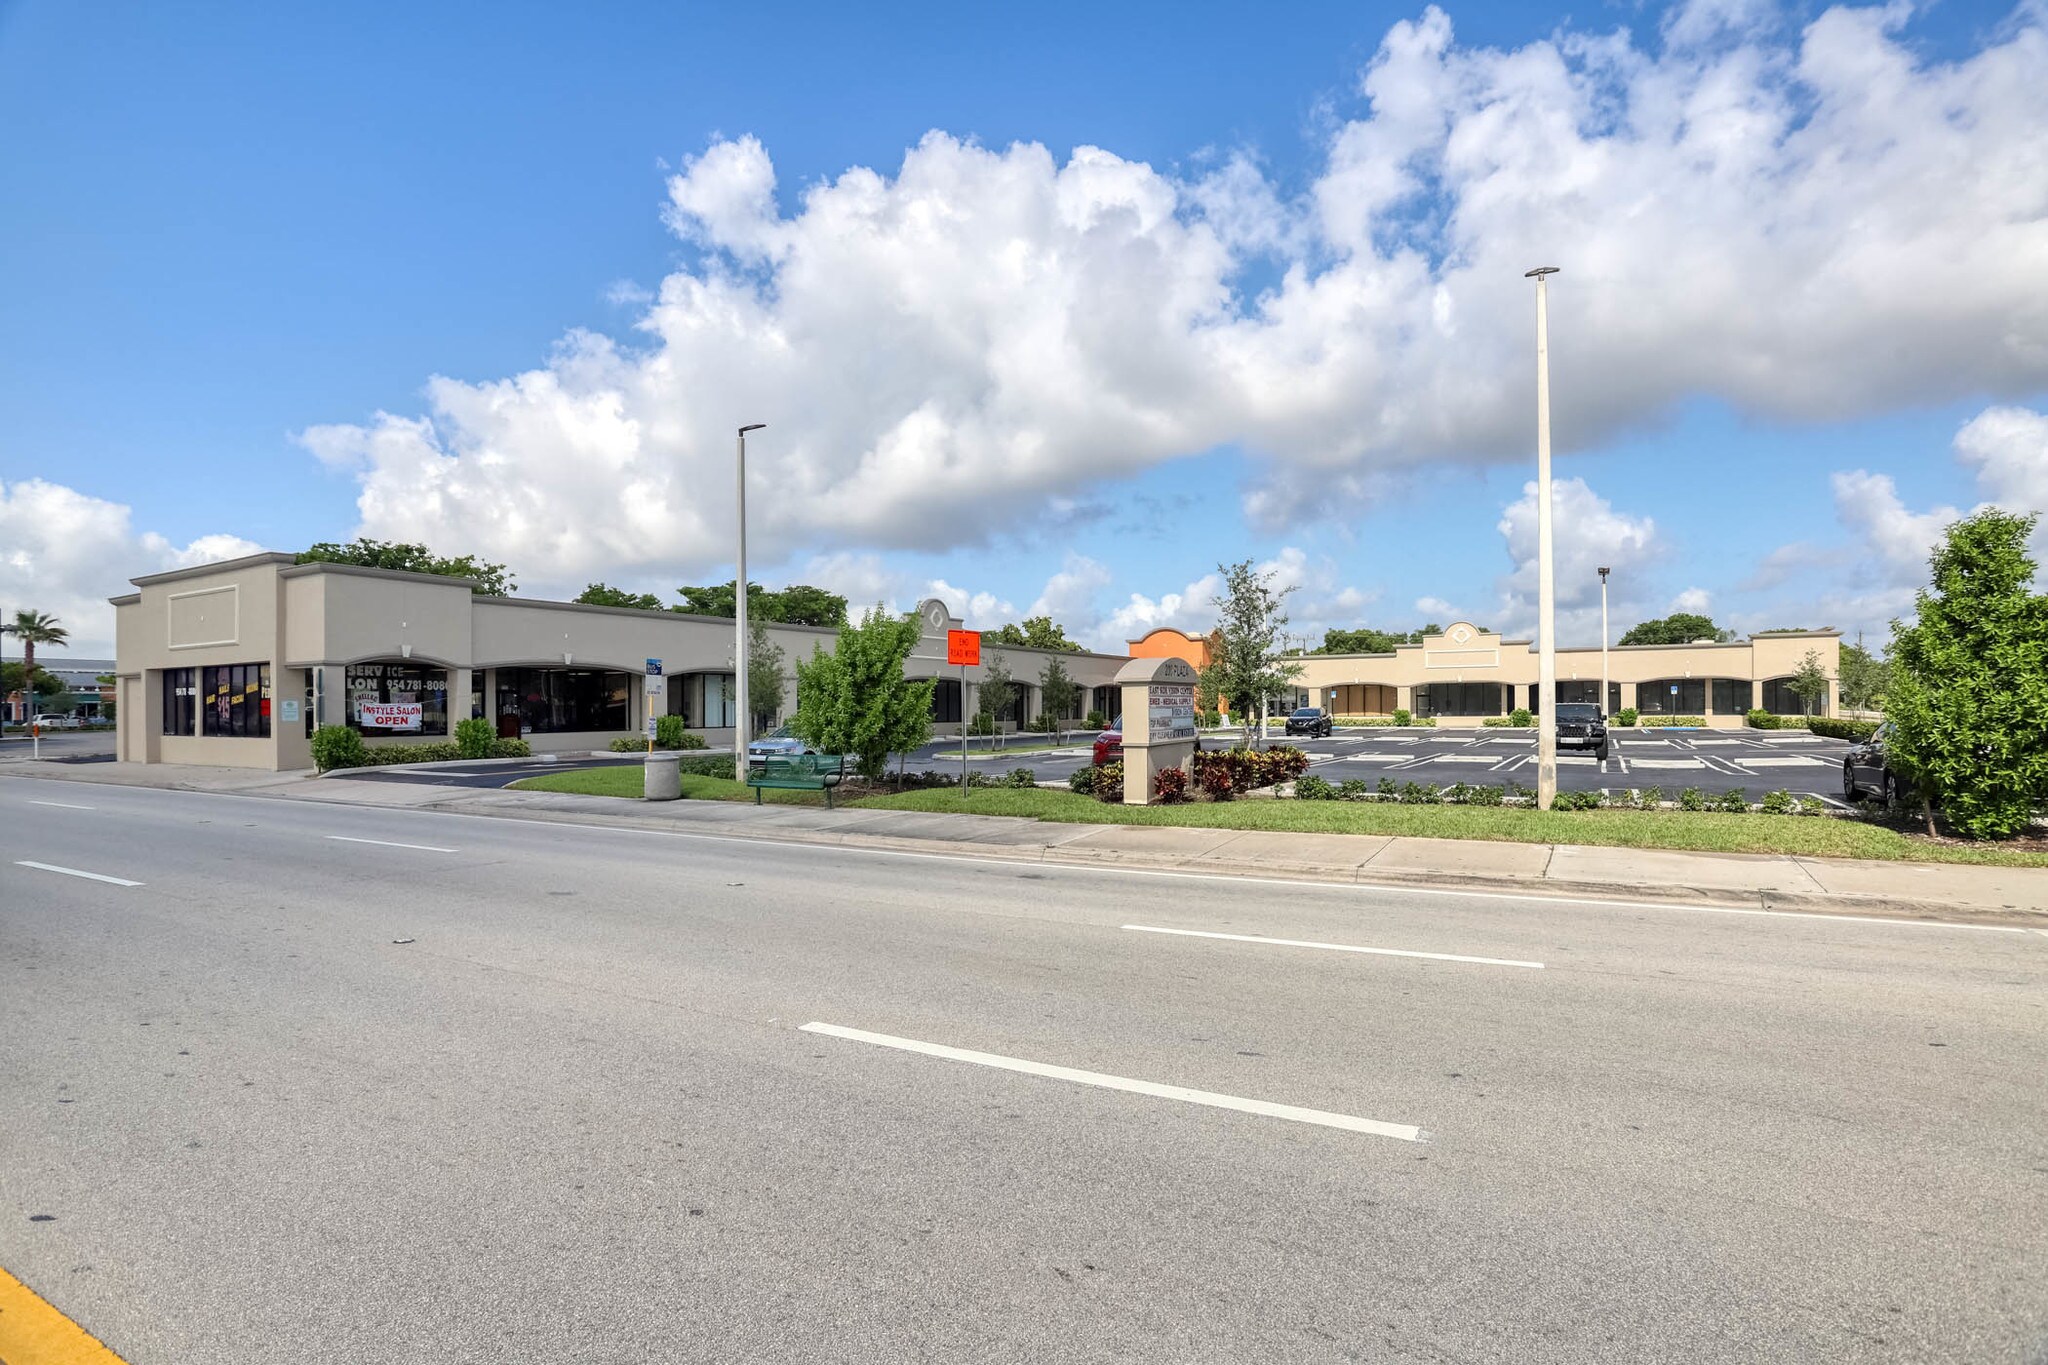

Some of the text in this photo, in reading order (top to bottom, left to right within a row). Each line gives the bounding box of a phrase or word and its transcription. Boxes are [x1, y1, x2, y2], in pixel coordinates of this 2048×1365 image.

[347, 678, 377, 690] LON
[363, 704, 421, 715] INSTYLE SALON
[375, 716, 409, 725] OPEN
